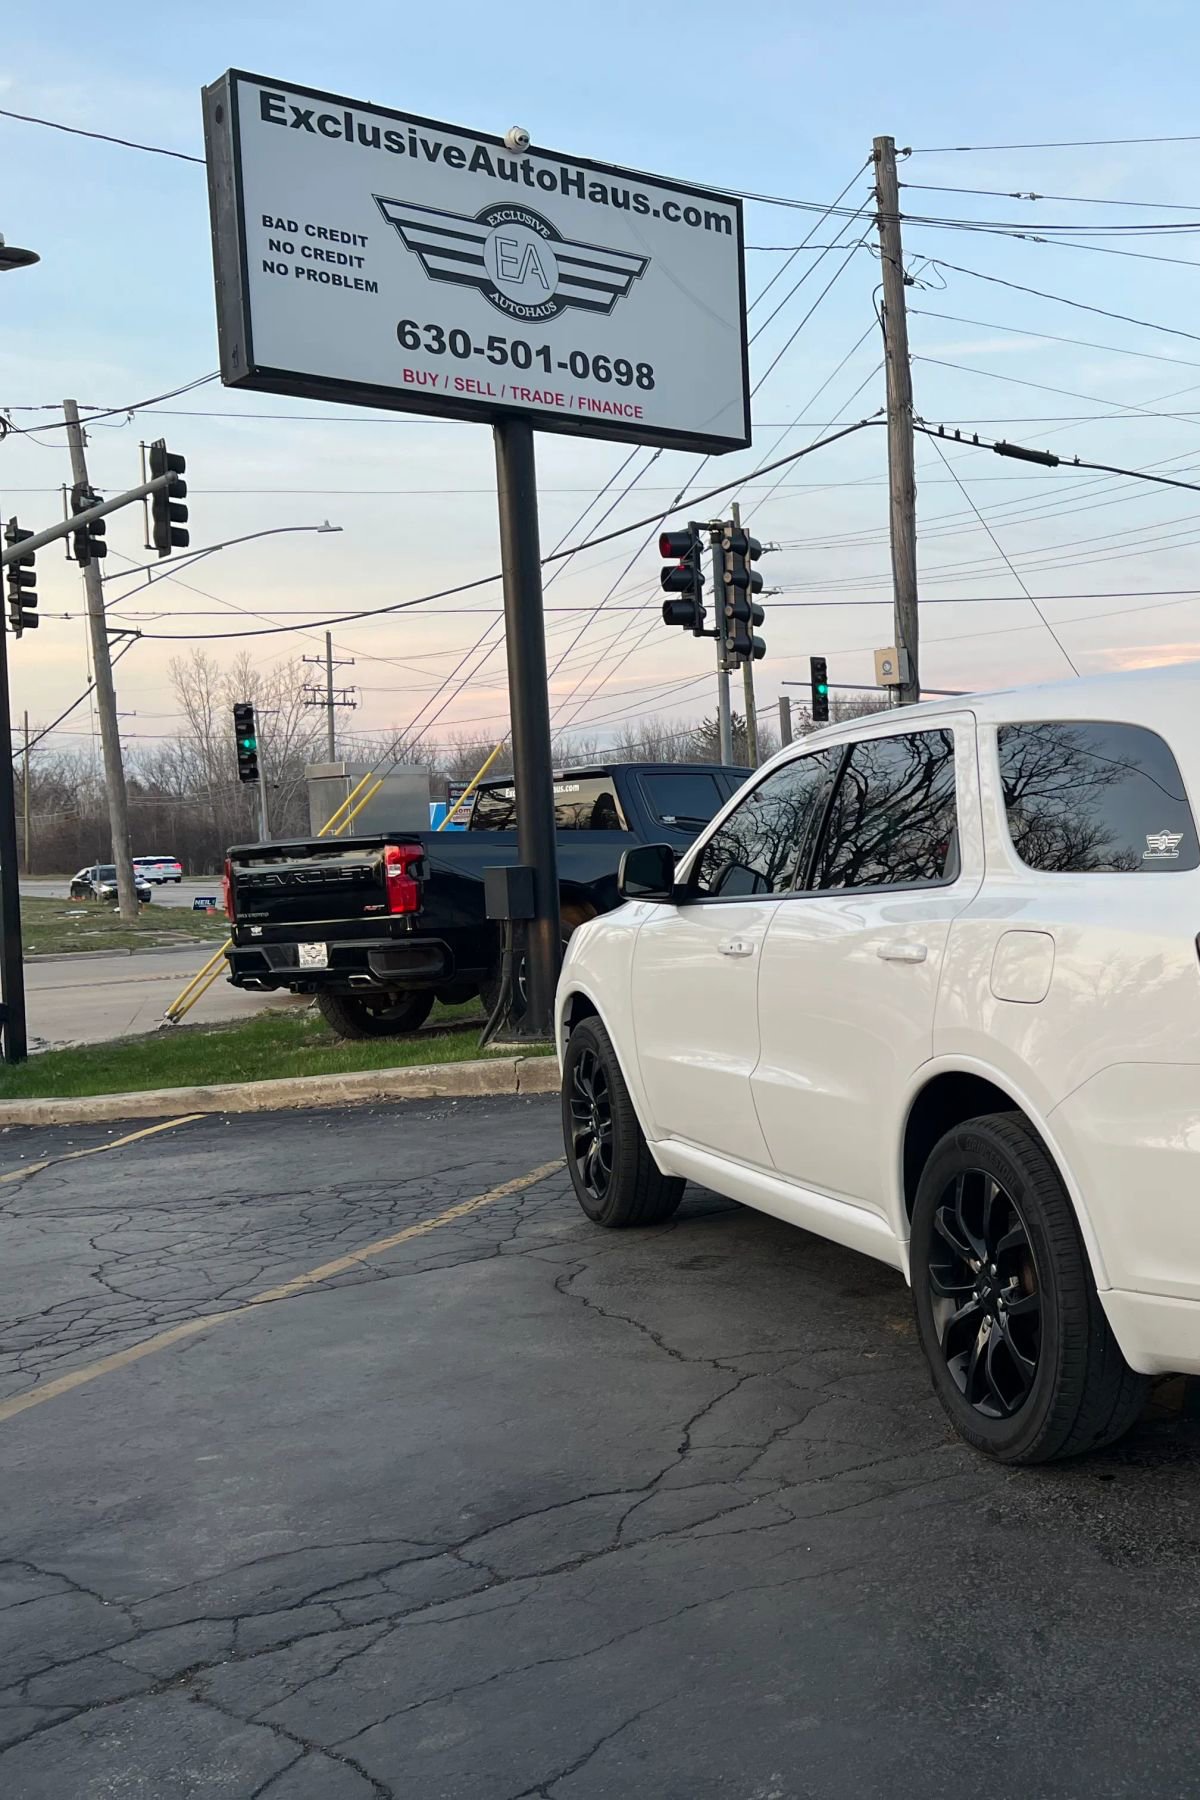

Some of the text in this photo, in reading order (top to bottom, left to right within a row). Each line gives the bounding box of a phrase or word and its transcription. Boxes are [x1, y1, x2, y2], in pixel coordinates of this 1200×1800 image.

[259, 89, 733, 236] ExclusiveAutoHaus.com
[261, 214, 369, 248] BAD CREDIT
[486, 210, 551, 239] EXCLUSIVE
[268, 238, 365, 269] NO CREDIT
[495, 235, 550, 290] EA
[261, 259, 379, 294] NO PROBLEM
[488, 292, 558, 318] AUTOHAUS
[396, 319, 656, 391] 630-501-0698
[403, 368, 439, 387] BUY
[454, 377, 497, 397] SELL
[510, 385, 565, 407] TRADE
[578, 396, 644, 419] FINANCE
